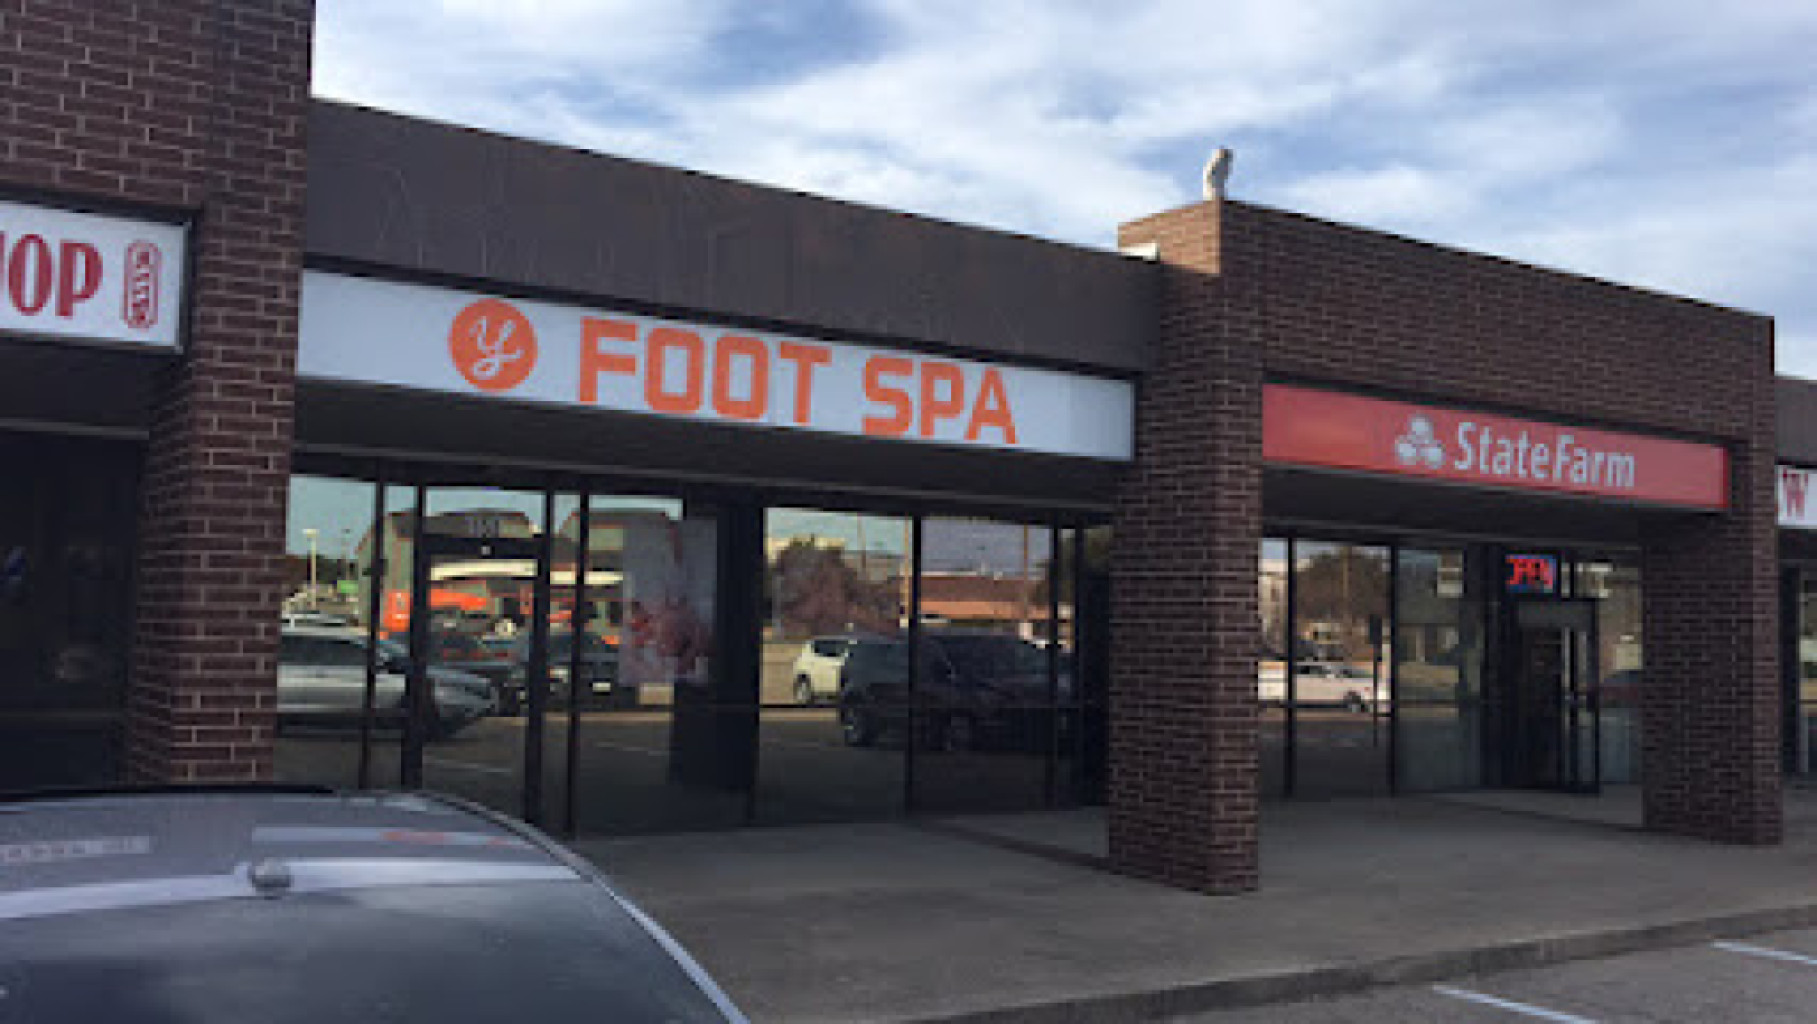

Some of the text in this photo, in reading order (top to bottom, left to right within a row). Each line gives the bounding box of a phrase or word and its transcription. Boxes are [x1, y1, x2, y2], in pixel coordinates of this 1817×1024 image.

[0, 231, 103, 319] OP
[578, 315, 832, 426] FOOT
[862, 354, 1018, 444] SPA
